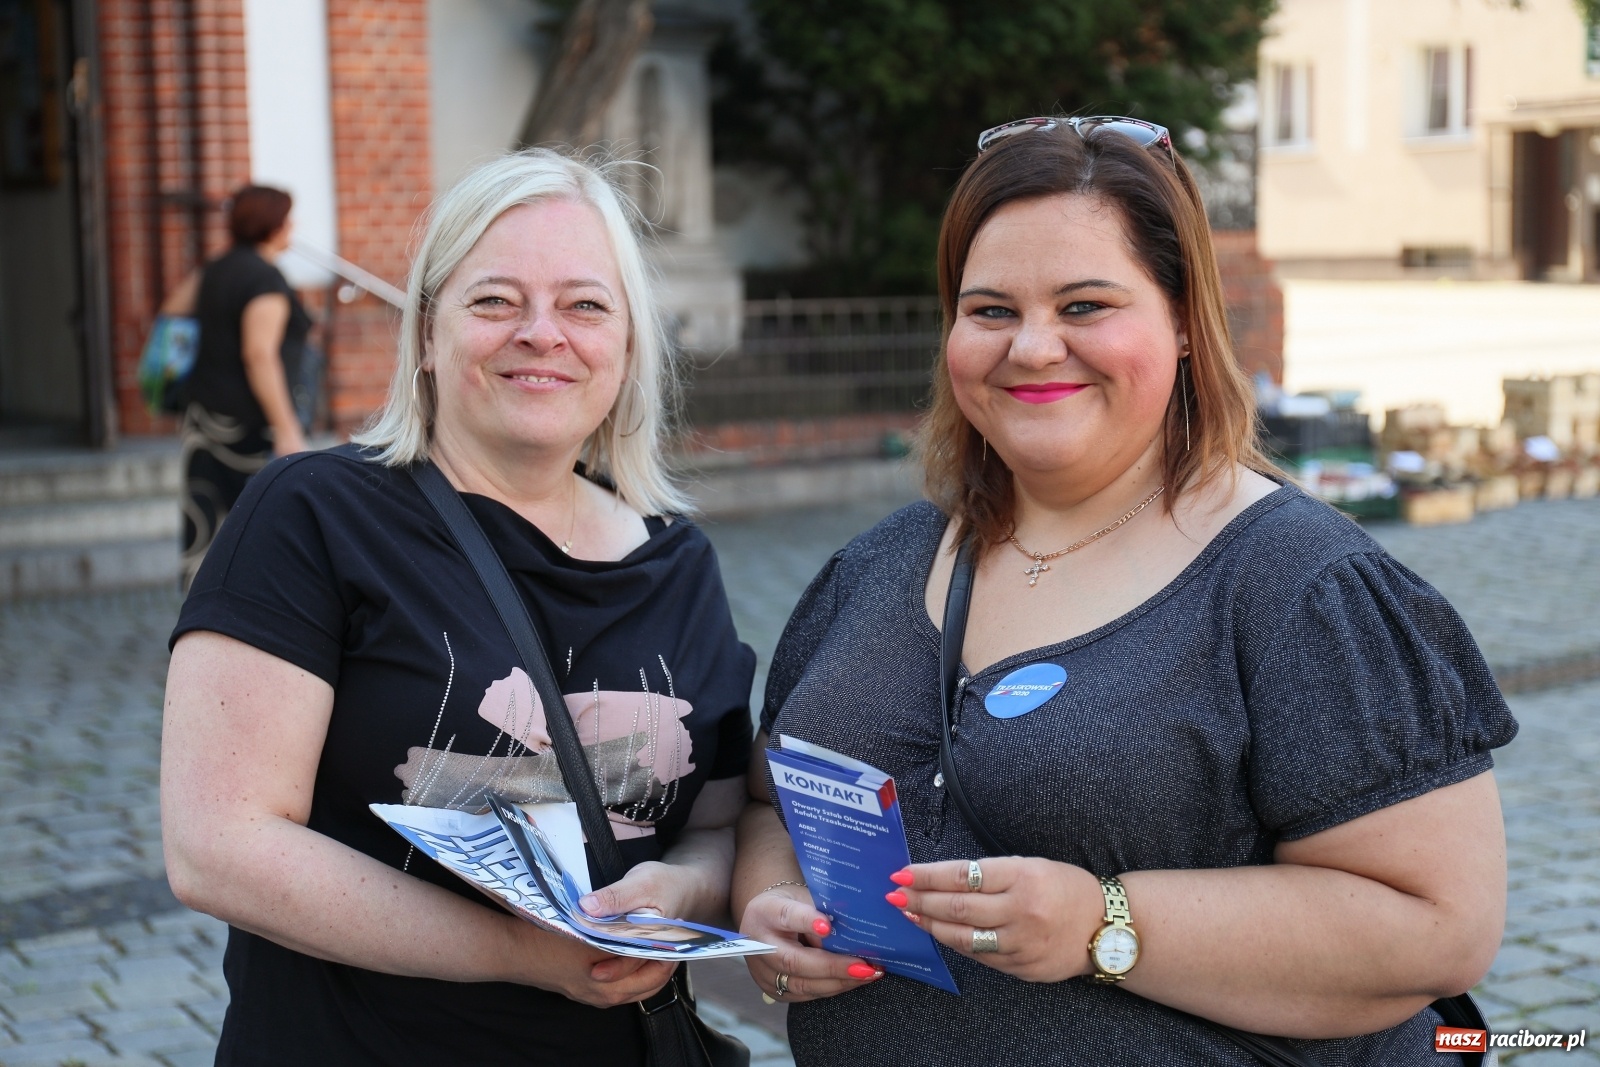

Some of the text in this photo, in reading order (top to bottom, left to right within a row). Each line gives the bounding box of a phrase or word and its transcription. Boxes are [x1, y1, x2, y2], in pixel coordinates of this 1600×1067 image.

[783, 771, 864, 805] KONTAKT
[791, 800, 889, 833] Otwarty Sztab Obywatelski
[818, 815, 877, 836] Trzaskowskiego
[803, 841, 830, 854] KONTAKT
